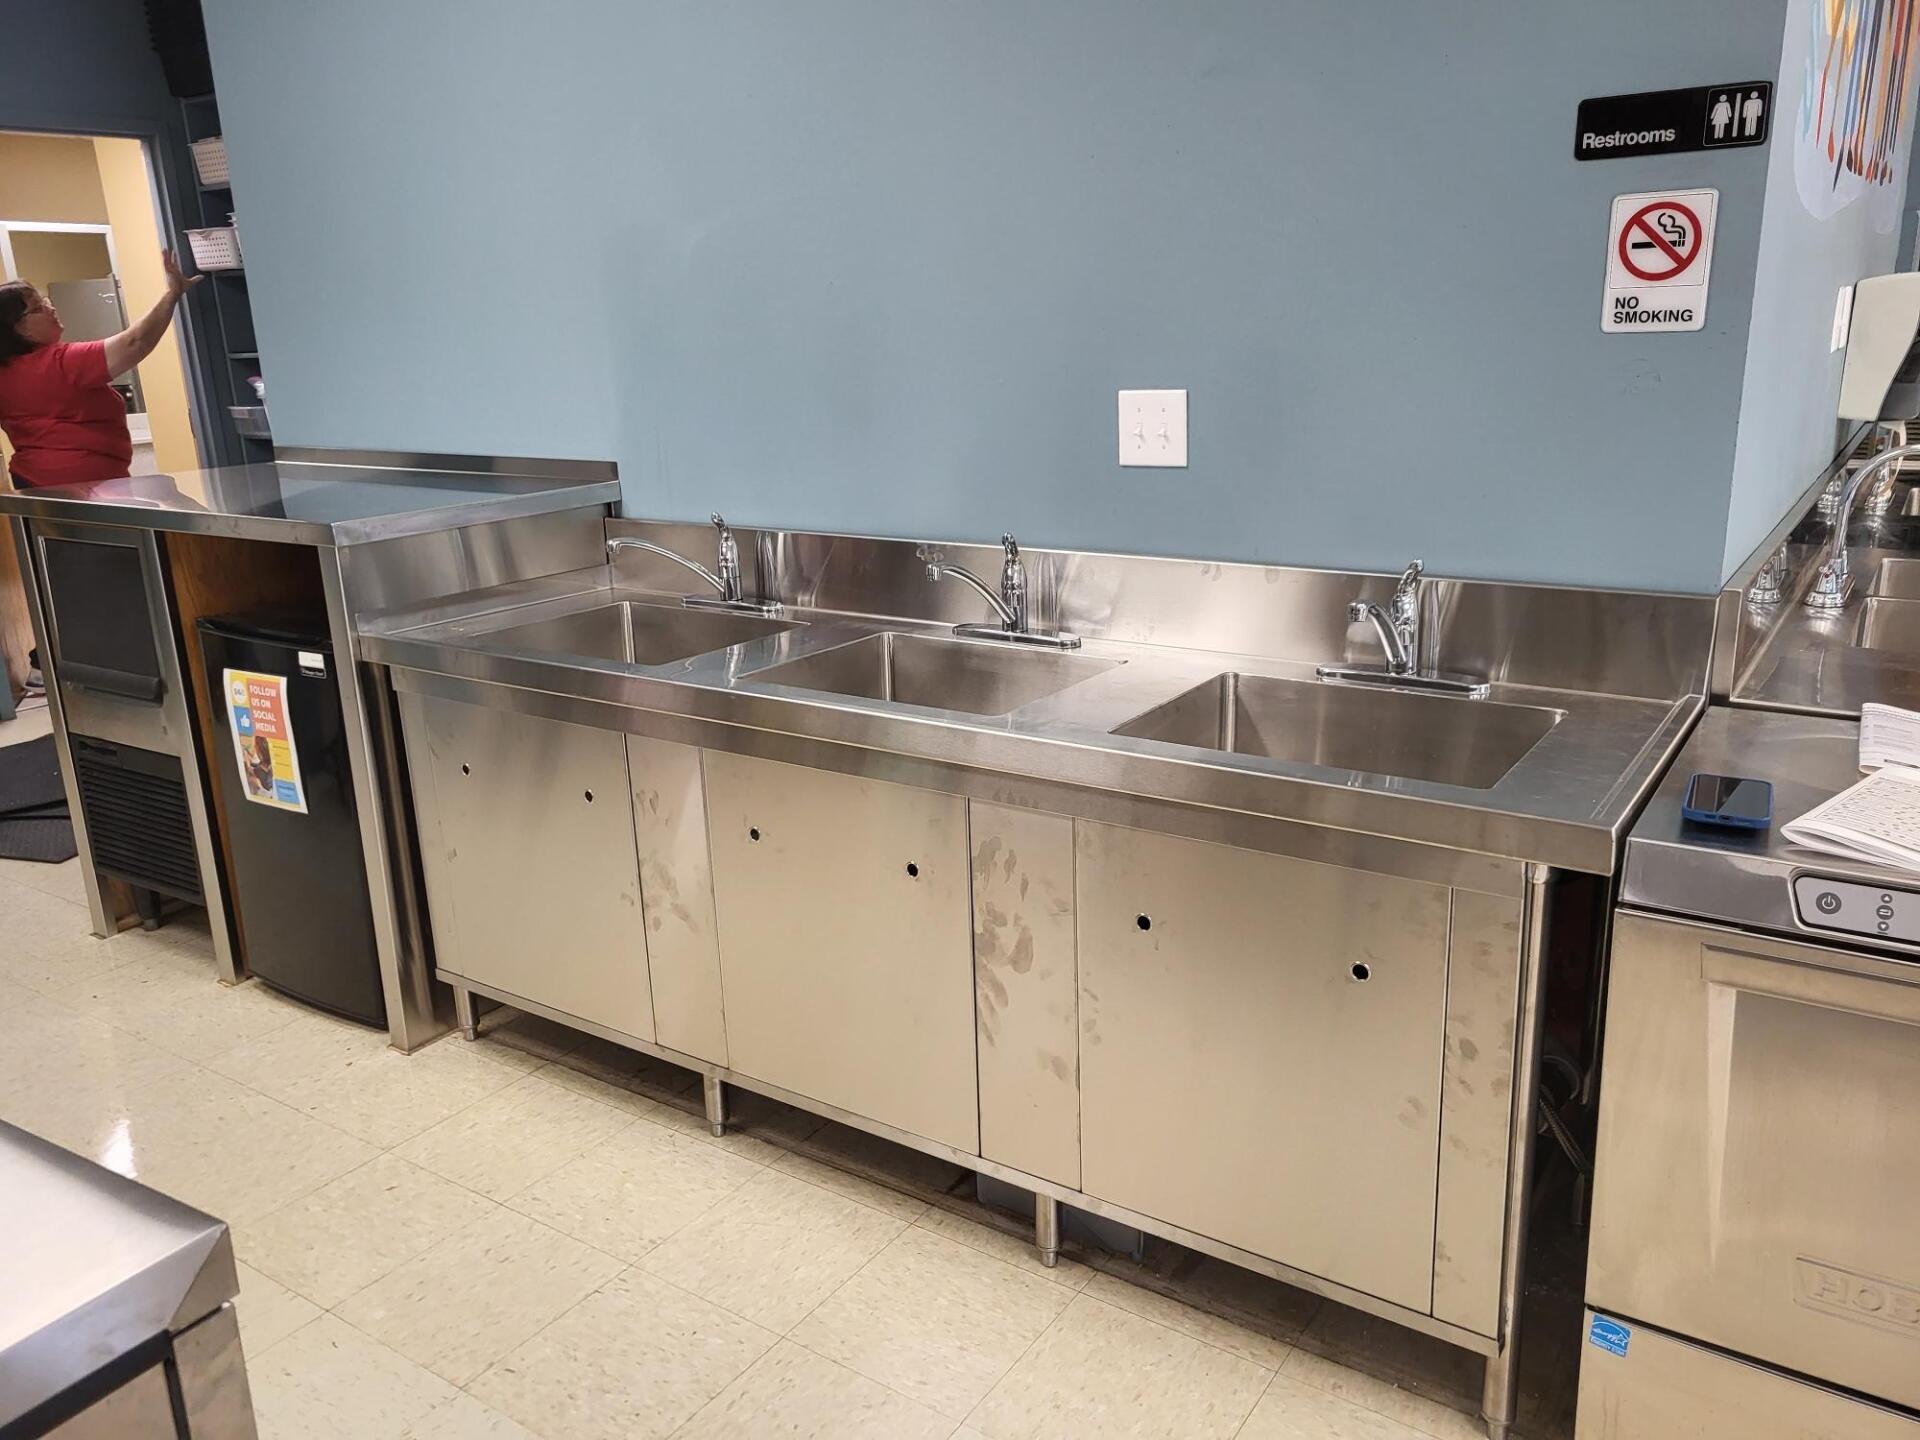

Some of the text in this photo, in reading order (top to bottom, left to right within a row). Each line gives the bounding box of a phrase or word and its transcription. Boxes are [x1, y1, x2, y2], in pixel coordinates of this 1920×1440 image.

[1582, 128, 1676, 150] Restrooms
[1614, 296, 1640, 310] NO
[1613, 309, 1694, 324] SMOKING
[249, 684, 277, 697] FOLLOW
[251, 697, 272, 709] US ON
[253, 709, 277, 722] SOCIAL
[255, 721, 277, 733] MEDIA
